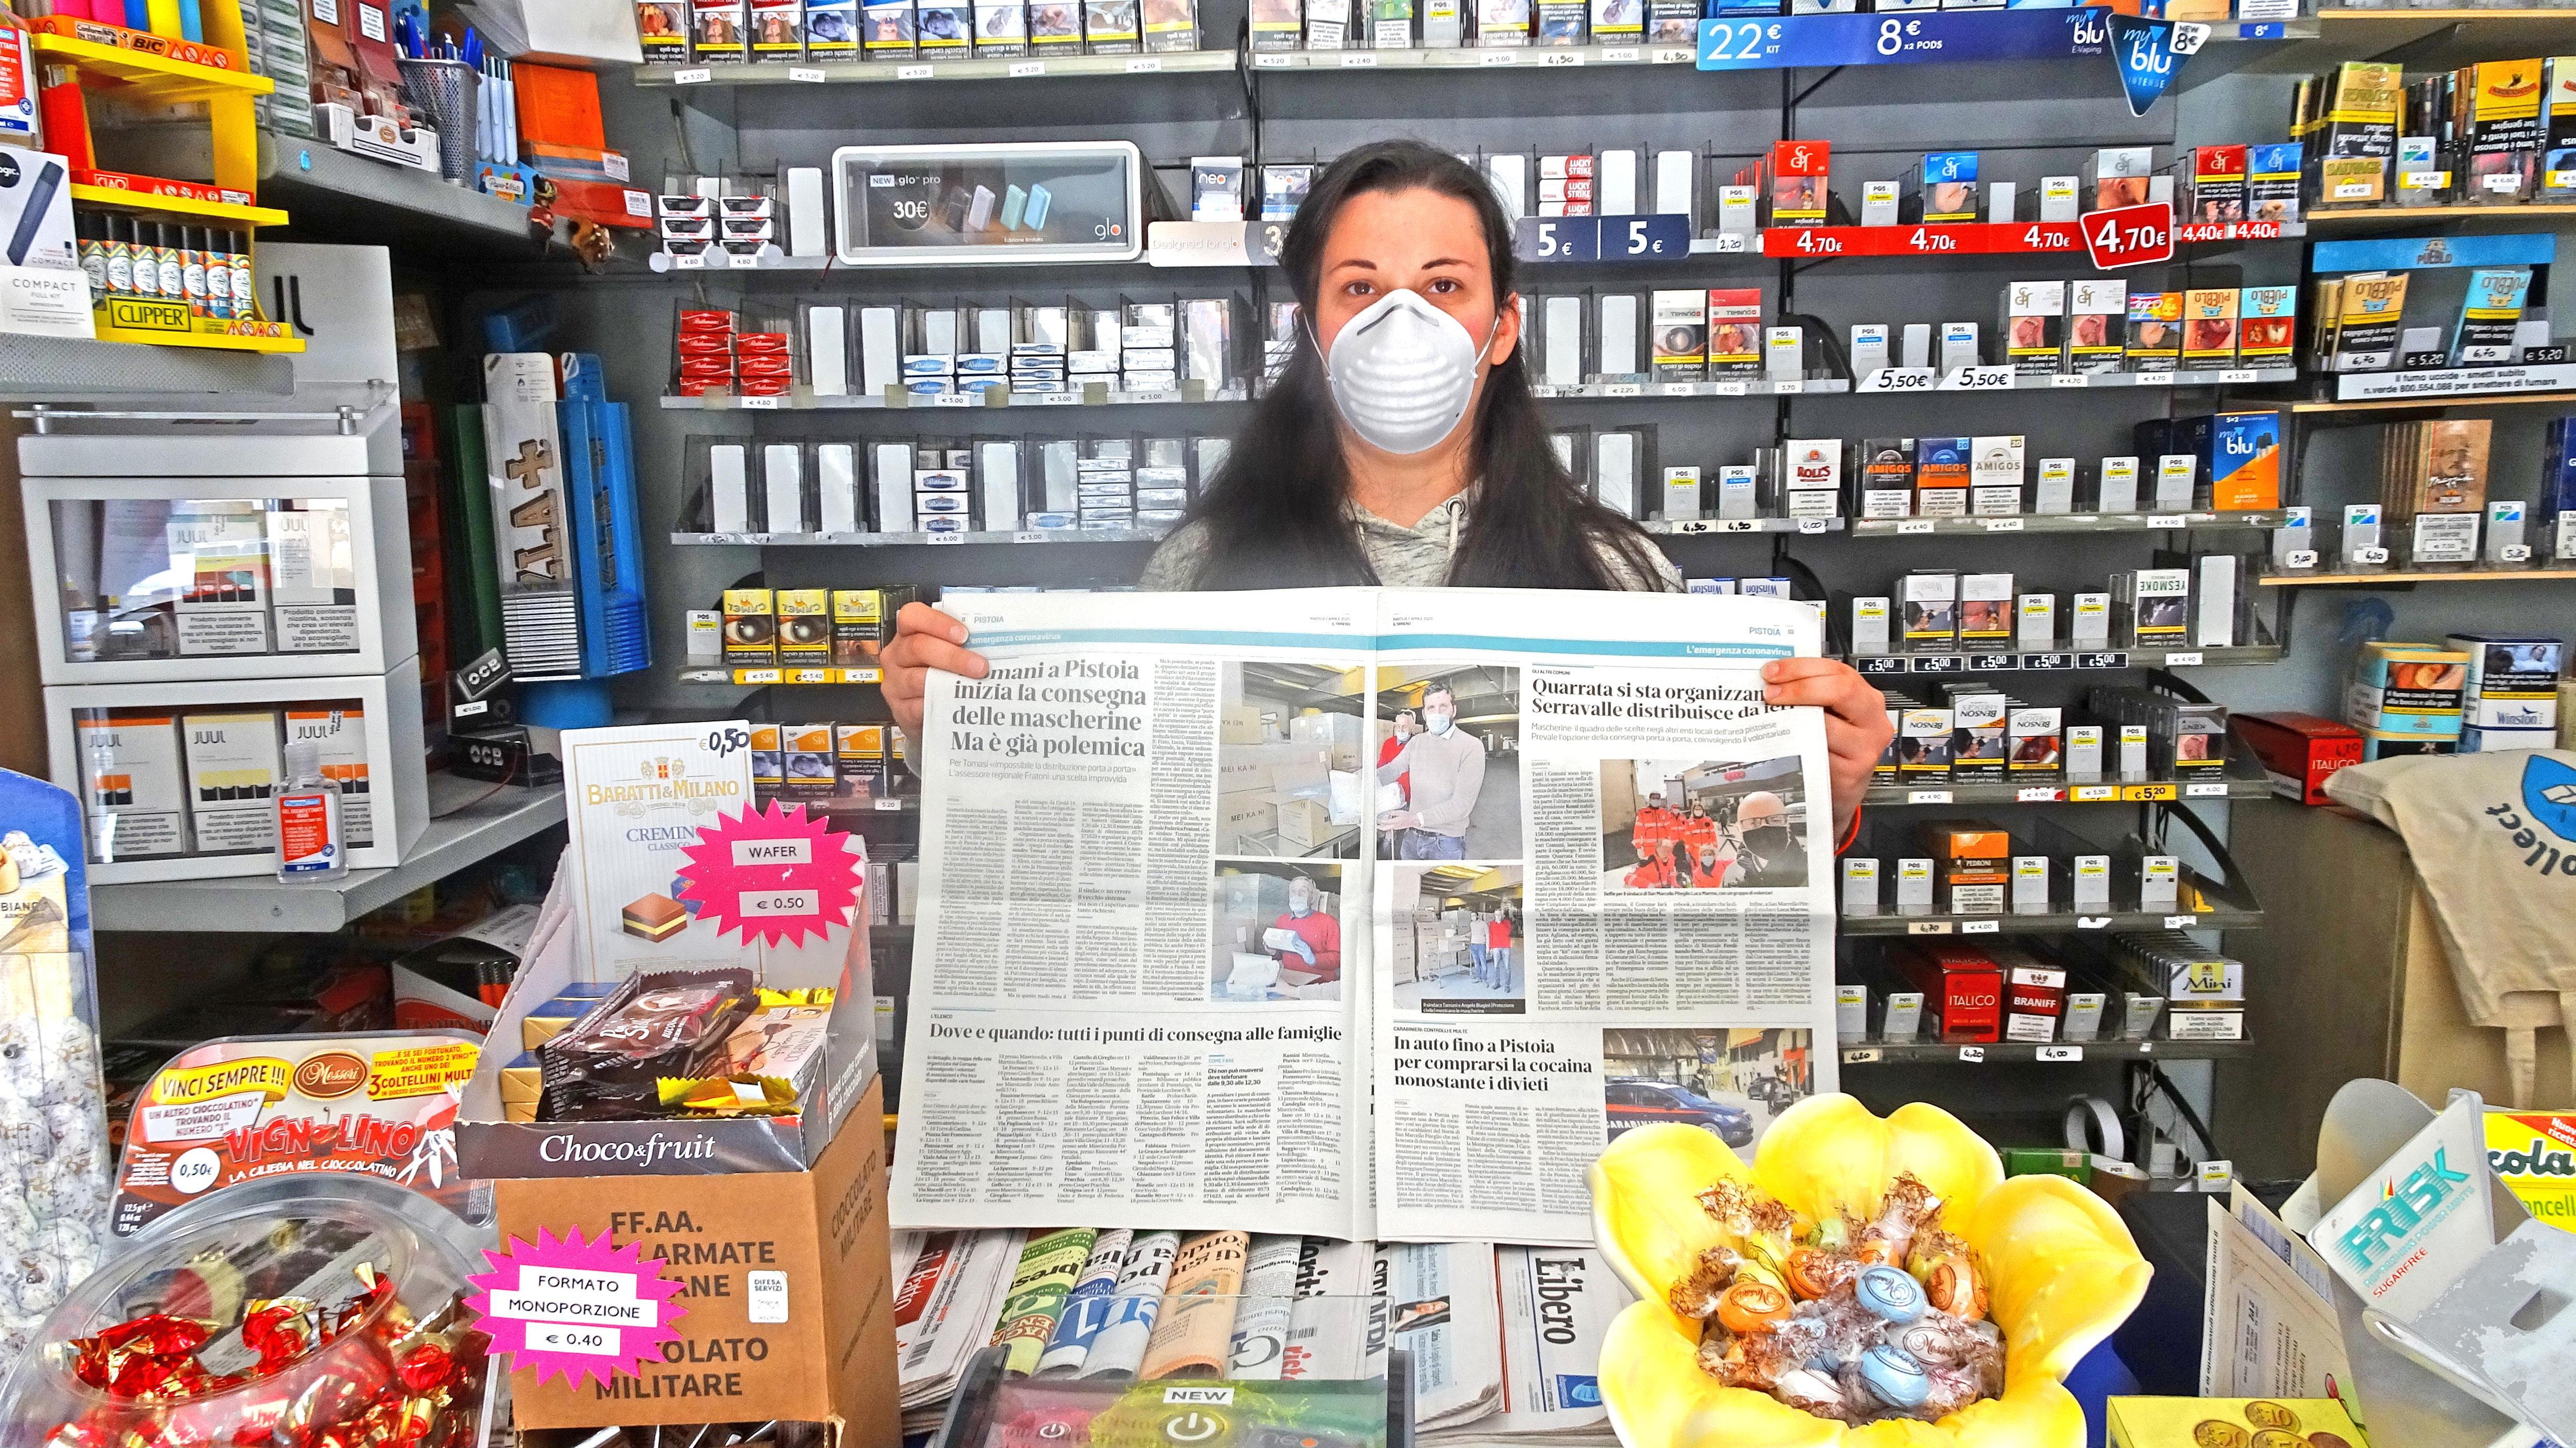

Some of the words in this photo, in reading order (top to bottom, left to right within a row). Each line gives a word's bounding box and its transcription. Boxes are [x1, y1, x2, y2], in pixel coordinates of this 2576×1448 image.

[1707, 23, 1763, 60] 22
[1767, 24, 1781, 39] €
[1877, 19, 1901, 55] 8
[1906, 20, 1920, 35] €
[2074, 23, 2104, 44] blu
[1917, 41, 1943, 49] PODS
[2071, 46, 2101, 55] E-Vaping
[2130, 42, 2171, 75] blu
[1568, 167, 1592, 176] STRIKE
[1569, 159, 1591, 168] LUCKY
[97, 176, 126, 189] CIAO
[923, 176, 940, 186] pro
[1198, 174, 1225, 184] neo
[894, 202, 928, 218] 30€
[1094, 218, 1121, 239] glo
[1628, 221, 1647, 254] 5
[1653, 240, 1663, 253] €
[2024, 226, 2070, 248] 4,70€
[2095, 219, 2166, 253] 4,70€
[2183, 226, 2223, 240] 4,40€
[2237, 224, 2278, 238] 4,40€
[1537, 224, 1557, 257] 5
[1562, 243, 1572, 255] €
[1797, 230, 1843, 253] 4,70€
[1910, 228, 1957, 250] 4,70€
[13, 279, 75, 291] COMPACT
[118, 305, 184, 326] CLIPPER
[2420, 354, 2443, 365] 5.20
[1878, 370, 1928, 389] 5,50€
[1959, 367, 2009, 386] 5,50€
[2403, 374, 2426, 382] fumo
[2498, 368, 2525, 377] subito
[2454, 383, 2470, 391] per
[2472, 380, 2511, 389] smettere
[1866, 463, 1911, 474] AMIGOS
[1976, 461, 2020, 472] AMIGOS
[1749, 627, 1780, 636] PISTOIA
[1687, 645, 1741, 656] L'emergenza
[1743, 646, 1792, 656] coronavirus
[469, 656, 502, 687] OCB
[986, 661, 1043, 680] mani
[1048, 665, 1059, 677] a
[1064, 659, 1139, 679] Pistoia
[954, 681, 1012, 701] inizia
[1018, 683, 1036, 701] la
[1042, 685, 1146, 709] consegna
[1533, 678, 1612, 697] Quarrata
[1617, 682, 1631, 697] si
[1636, 683, 1661, 699] sta
[1665, 685, 1764, 703] organizzan
[1533, 698, 1623, 718] Serravalle
[1627, 700, 1733, 720] distribuisce
[1738, 705, 1759, 718] da
[2496, 712, 2537, 724] Winston
[953, 707, 1005, 725] delle
[1011, 707, 1142, 731] mascherine
[194, 730, 226, 745] JUUL
[298, 726, 328, 739] JUUL
[952, 732, 984, 751] Ma
[989, 734, 1002, 751] è
[1006, 734, 1038, 757] già
[1043, 737, 1145, 757] polemica
[470, 744, 504, 766] OCB
[627, 826, 698, 842] CREMIN
[749, 846, 797, 858] WAFER
[757, 900, 767, 909] €
[774, 898, 804, 909] 0.50
[2183, 977, 2231, 991] Mini
[1949, 994, 1995, 1006] ITALICO
[2014, 997, 2056, 1008] BRANIFF
[930, 1023, 972, 1039] Dove
[977, 1027, 985, 1039] e
[988, 1025, 1054, 1042] quando:
[1058, 1027, 1091, 1041] tutti
[1095, 1028, 1100, 1041] i
[1104, 1028, 1144, 1043] punti
[1149, 1026, 1163, 1041] di
[1167, 1028, 1242, 1044] consegna
[1245, 1026, 1273, 1040] alle
[1278, 1025, 1342, 1042] famiglie
[1394, 1036, 1410, 1050] In
[1414, 1038, 1448, 1052] auto
[1453, 1037, 1483, 1053] fino
[1487, 1041, 1497, 1053] a
[1501, 1039, 1555, 1053] Pistoia
[306, 1061, 360, 1086] Messori
[1394, 1057, 1421, 1071] per
[1425, 1058, 1508, 1073] comprarsi
[1513, 1059, 1525, 1073] la
[1530, 1059, 1592, 1073] cocaina
[163, 1078, 203, 1097] VINCI
[207, 1065, 268, 1092] SEMPRE
[368, 1074, 382, 1095] 3
[383, 1073, 440, 1088] COLTELLINI
[445, 1069, 474, 1082] MULT
[1394, 1075, 1485, 1090] nonostante
[1490, 1077, 1494, 1090] i
[1497, 1077, 1548, 1092] divieti
[2487, 1140, 2576, 1176] cola
[229, 1170, 246, 1183] LA
[249, 1163, 294, 1178] CILIEGIA
[297, 1161, 319, 1170] NEL
[322, 1160, 396, 1178] CIOCCOLATINO
[2333, 1146, 2469, 1273] FRISK
[611, 1210, 703, 1234] FF.AA.
[652, 1241, 776, 1266] ARMATE
[2372, 1248, 2428, 1297] SUGARFREE
[538, 1275, 619, 1293] FORMATO
[508, 1299, 641, 1320] MONOPORZIONE
[1536, 1258, 1584, 1344] Libero
[546, 1335, 558, 1345] €
[566, 1333, 602, 1348] 0.40
[595, 1373, 742, 1400] MILITARE
[1172, 1391, 1227, 1401] NEW
